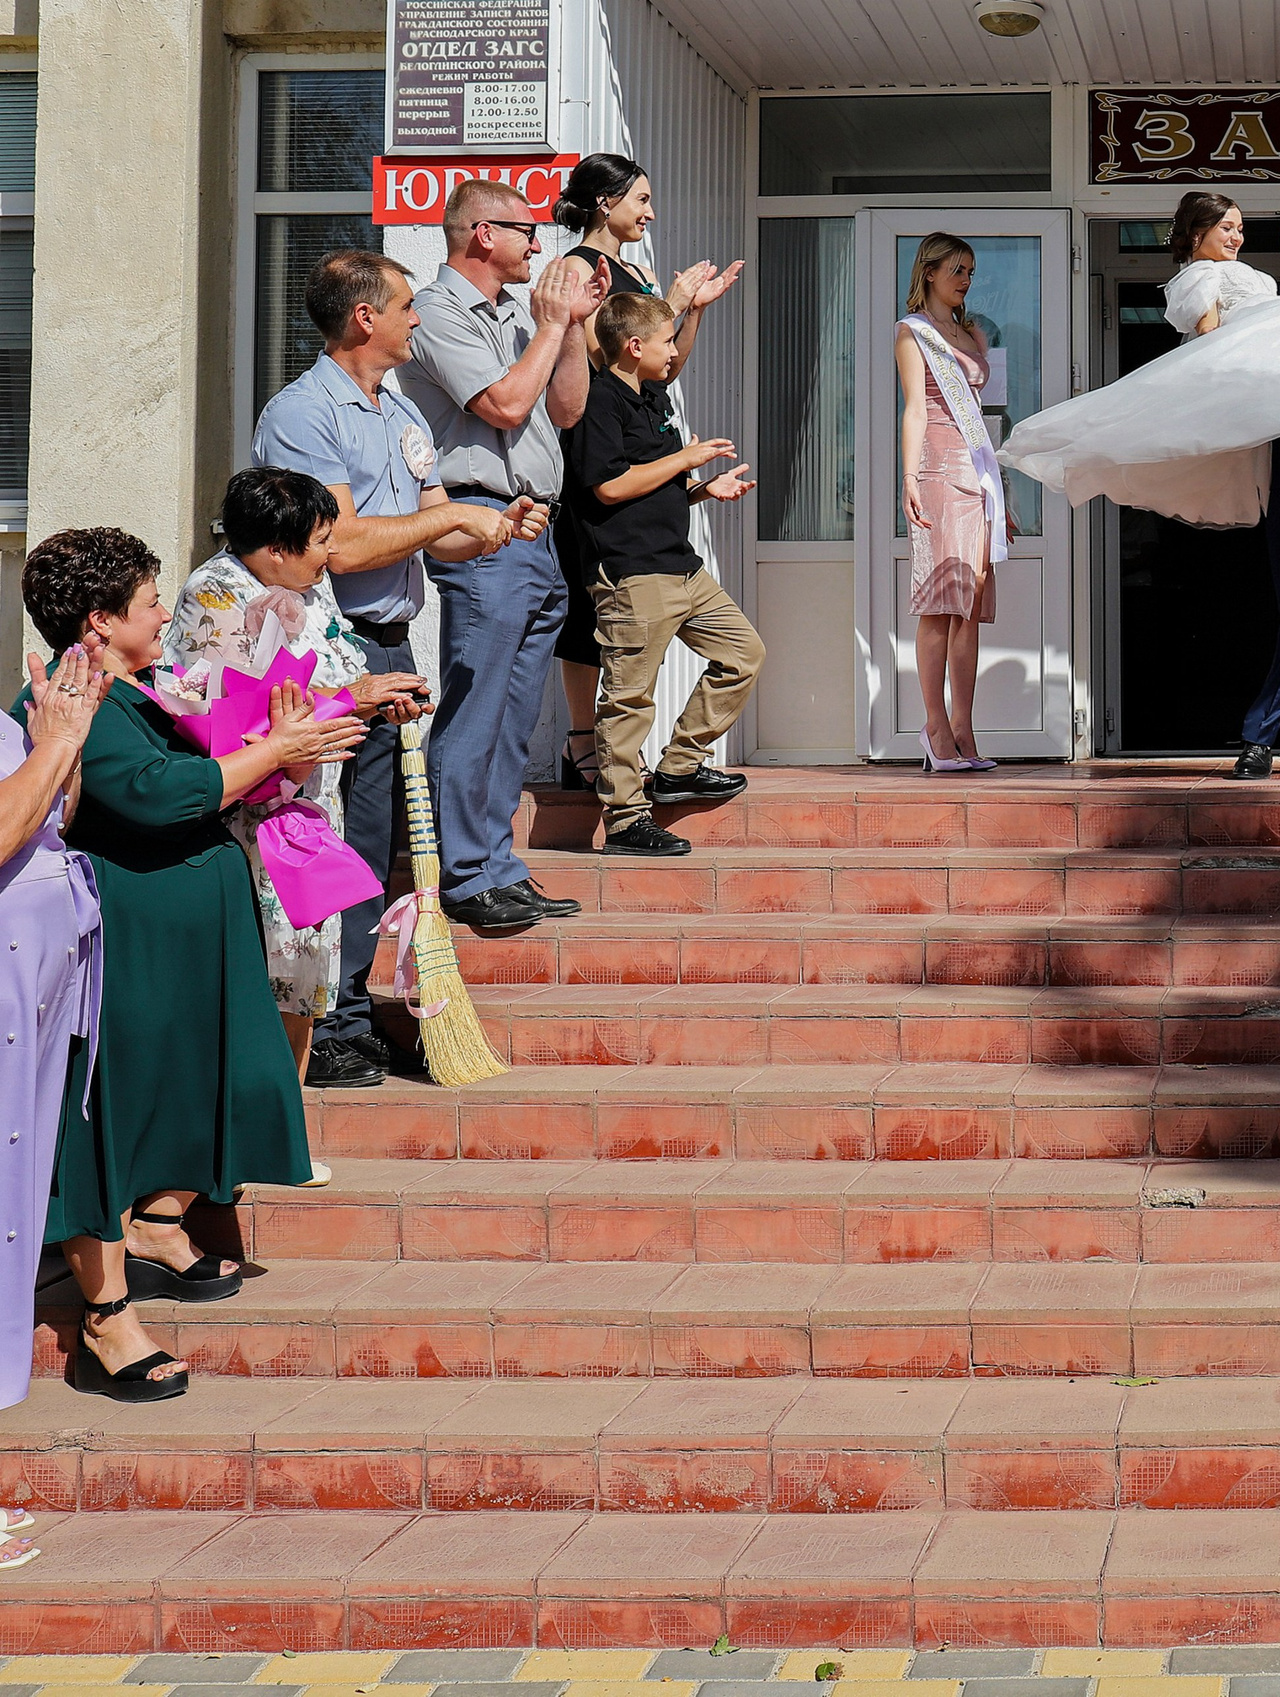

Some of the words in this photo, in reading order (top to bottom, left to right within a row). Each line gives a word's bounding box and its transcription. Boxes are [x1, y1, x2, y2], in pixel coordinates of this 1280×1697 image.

[406, 0, 475, 9] РОССИЙСКАЯ
[479, 0, 541, 9] ФЕДЕРАЦИЯ
[399, 10, 466, 19] УПРАВЛЕНИЕ
[470, 10, 512, 18] ЗАПИСИ
[515, 9, 548, 17] АКТОВ
[399, 20, 483, 29] ГРАЖДАНСКОГО
[487, 19, 548, 27] СОСТОЯНИЯ
[410, 29, 505, 38] КРАСНОДАРСКОГО
[509, 28, 537, 37] КРАЯ
[401, 41, 477, 60] ОТДЕЛ
[484, 40, 544, 57] ЗАГС
[400, 61, 495, 71] БЕЛОГЛИНСКОГО
[499, 59, 547, 69] РАЙОНА
[432, 73, 468, 81] РЕЖИМ
[472, 72, 513, 80] РАБОТЫ
[399, 86, 463, 95] ежедневно
[474, 84, 536, 93] 8.00-17.00
[399, 99, 449, 108] пятница
[474, 96, 536, 105] 8.00-16.00
[399, 110, 450, 120] перерыв
[470, 108, 538, 117] 12.00-12.50
[467, 121, 542, 130] воскресенье
[397, 126, 457, 136] выходной
[467, 131, 543, 140] понедельник
